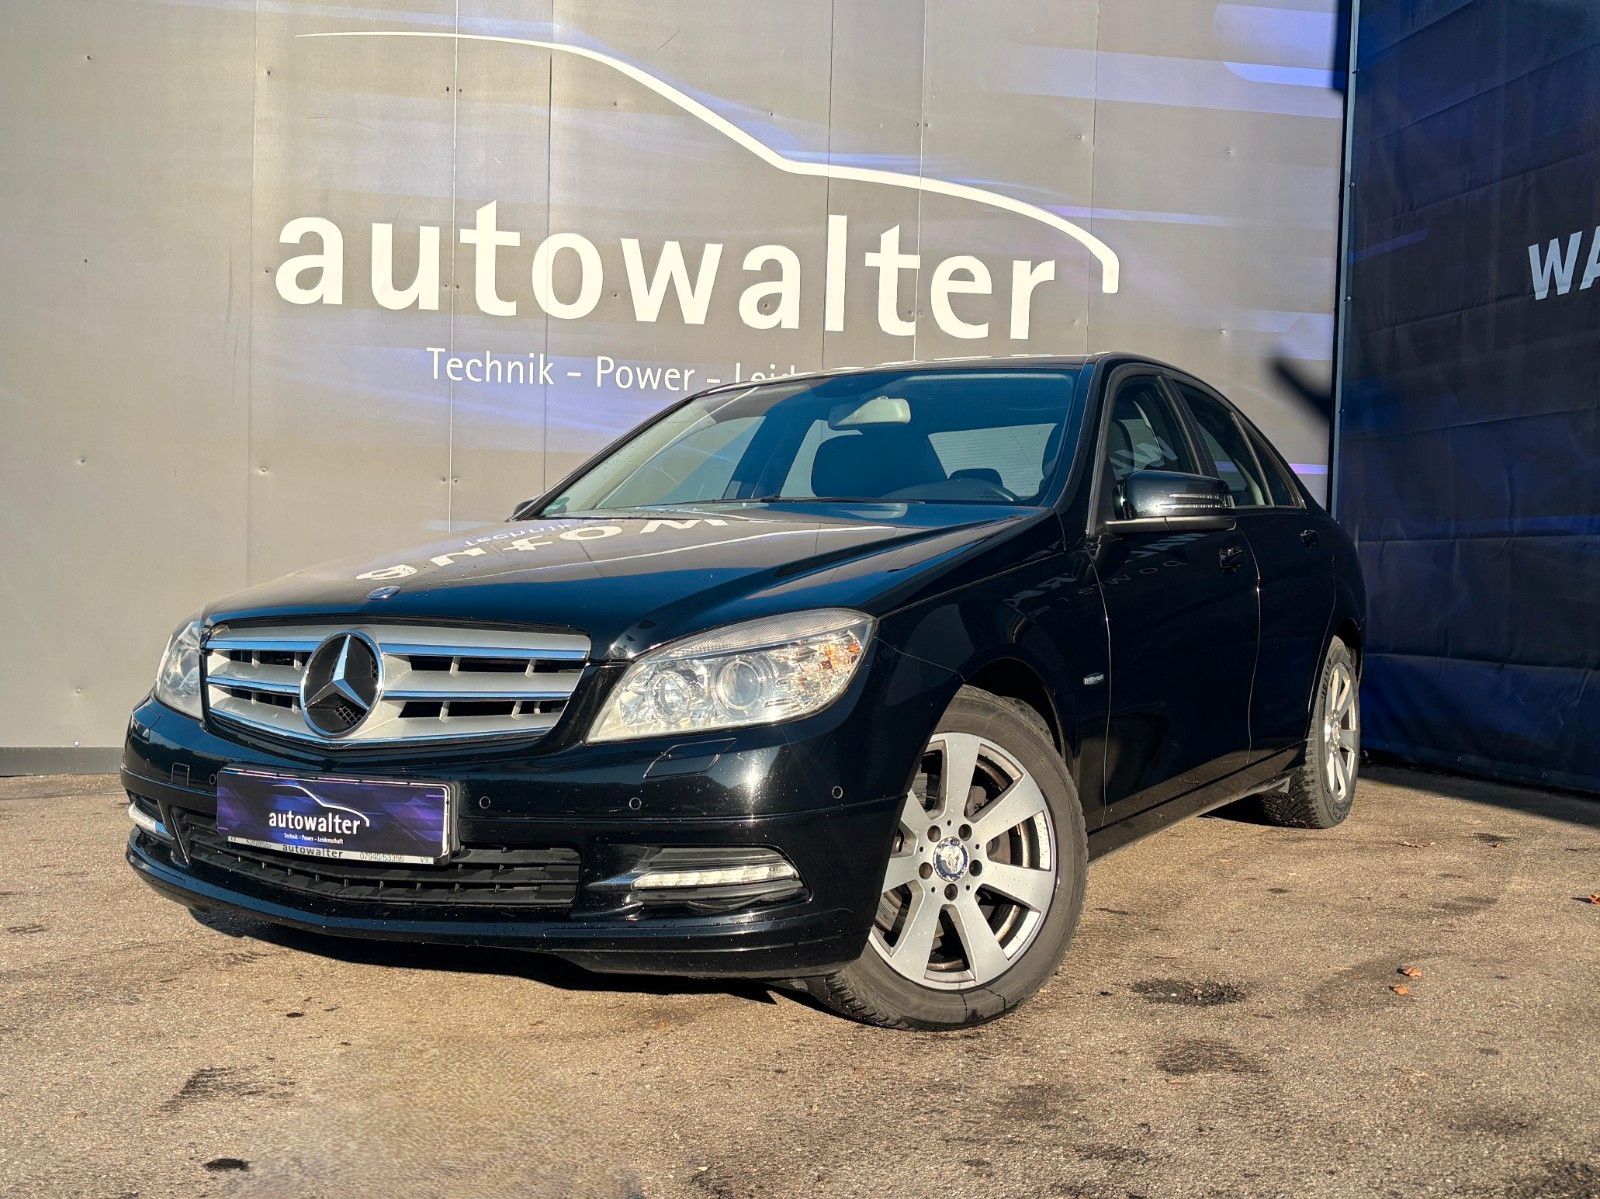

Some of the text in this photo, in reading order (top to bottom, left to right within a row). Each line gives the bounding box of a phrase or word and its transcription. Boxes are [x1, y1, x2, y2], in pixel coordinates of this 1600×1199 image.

[275, 200, 1055, 340] autowalter
[426, 347, 554, 385] Technik
[596, 356, 696, 392] Power
[268, 810, 361, 835] autowalter
[282, 844, 344, 858] autowalter
